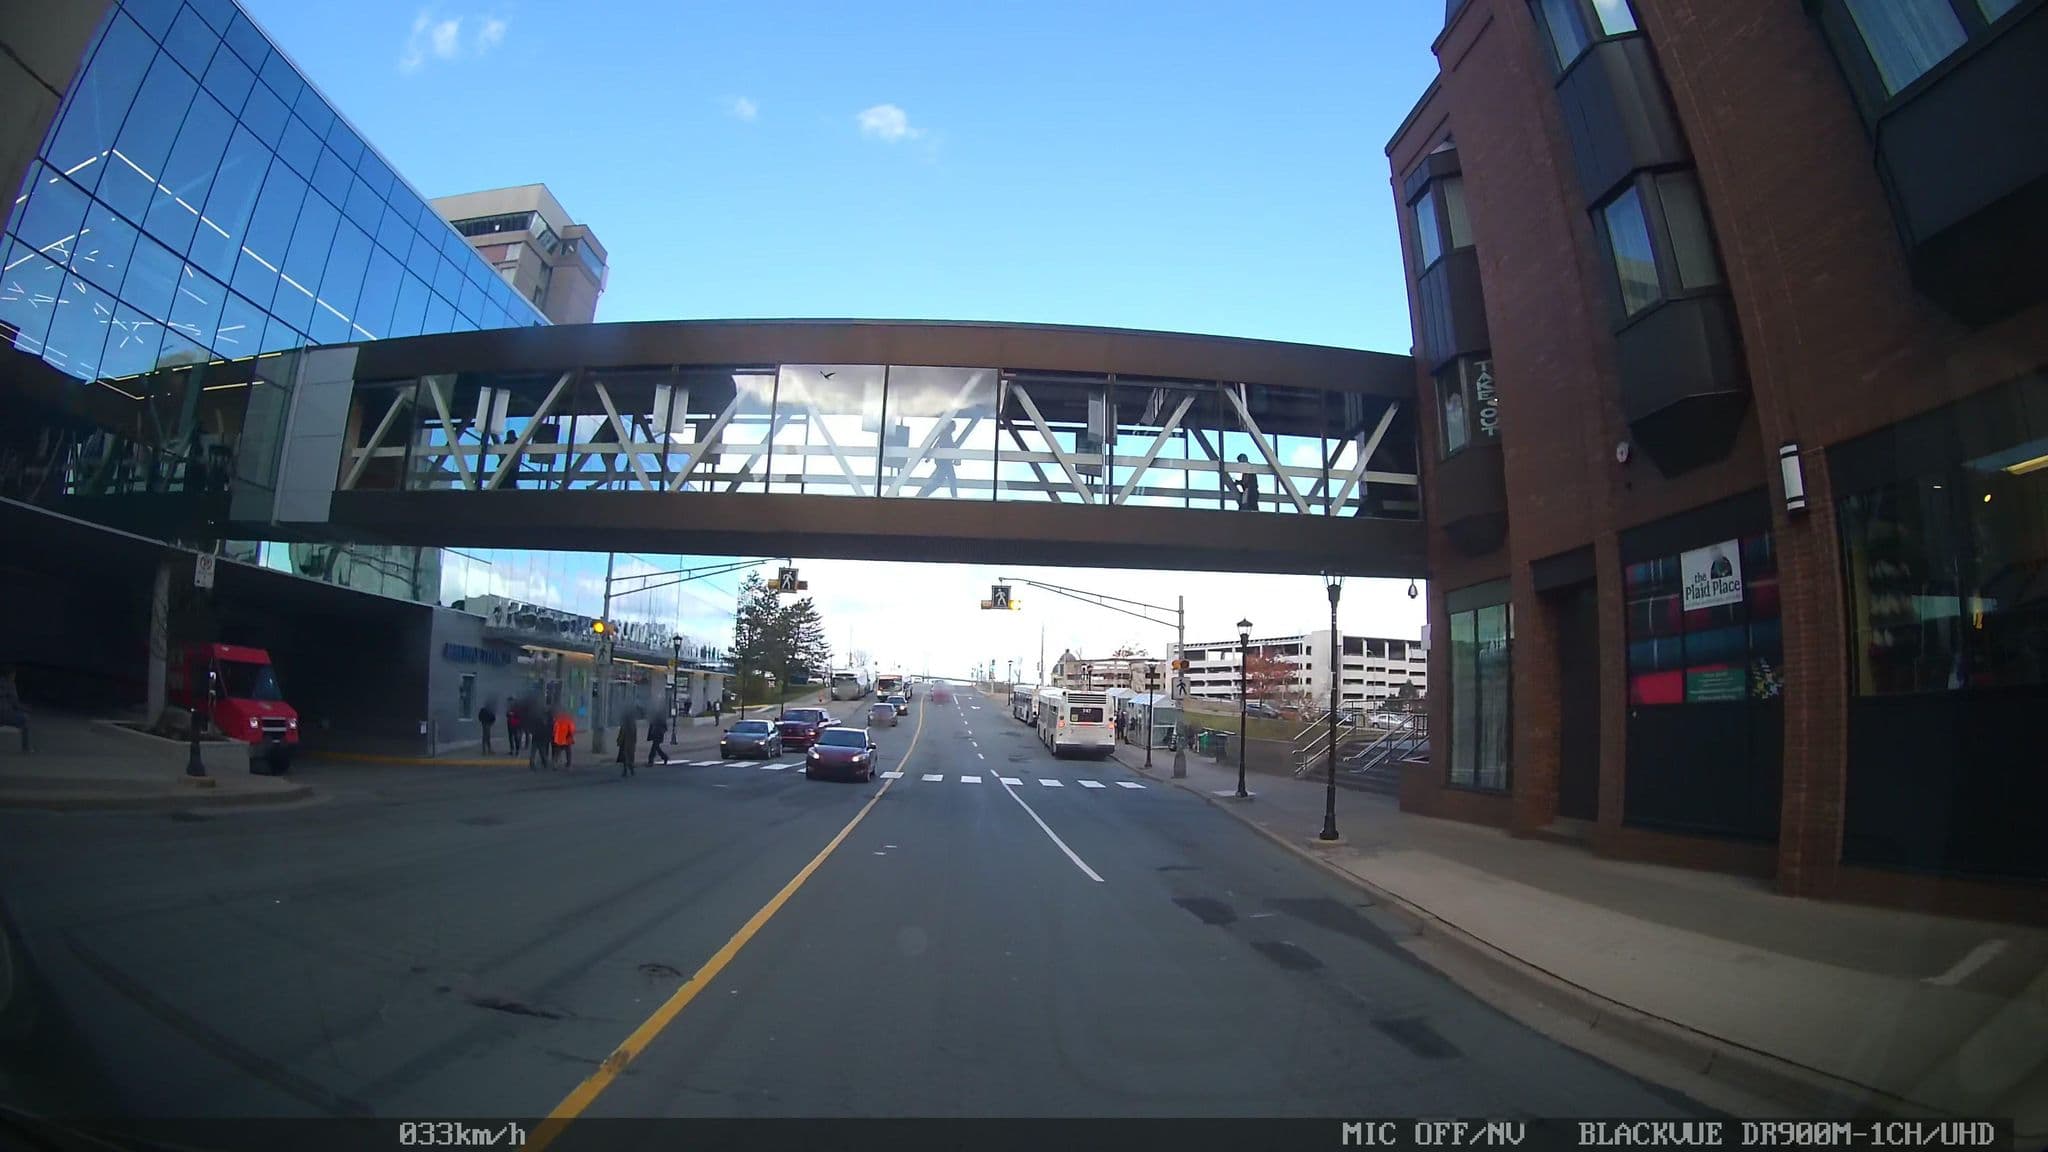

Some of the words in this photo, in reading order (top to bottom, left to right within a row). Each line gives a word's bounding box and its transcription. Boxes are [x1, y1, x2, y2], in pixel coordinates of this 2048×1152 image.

[1480, 407, 1499, 437] OUT
[1694, 572, 1707, 584] the
[1685, 580, 1711, 601] Plaid
[1712, 579, 1741, 596] Place
